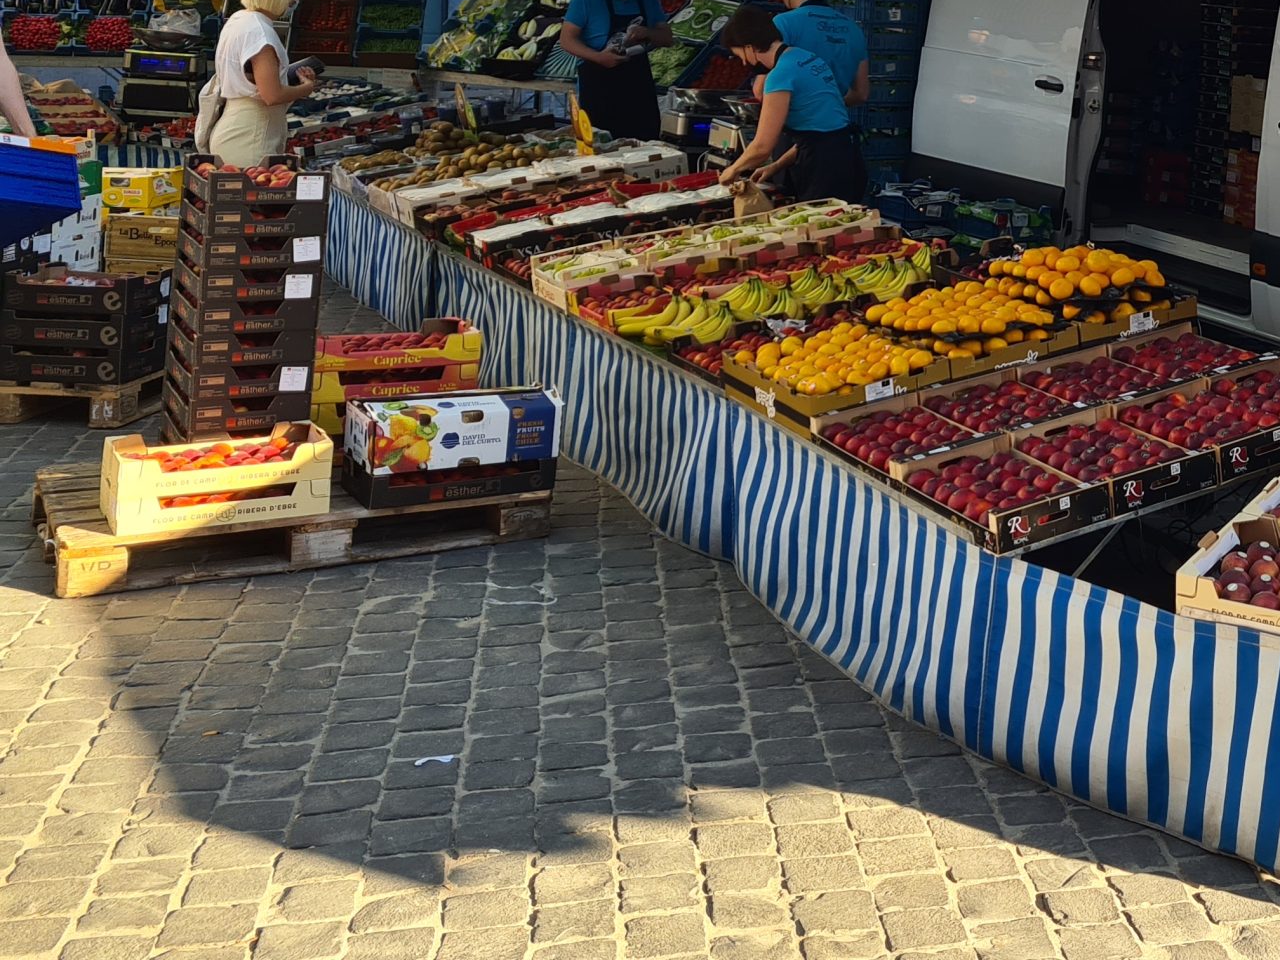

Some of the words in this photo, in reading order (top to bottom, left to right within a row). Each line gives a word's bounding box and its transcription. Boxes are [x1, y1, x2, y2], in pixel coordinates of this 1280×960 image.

[373, 354, 422, 367] Caprice
[372, 384, 420, 396] Caprice
[1123, 480, 1145, 498] R
[237, 504, 267, 515] RIBERA
[269, 502, 298, 512] D'EBRE
[1007, 515, 1031, 535] R
